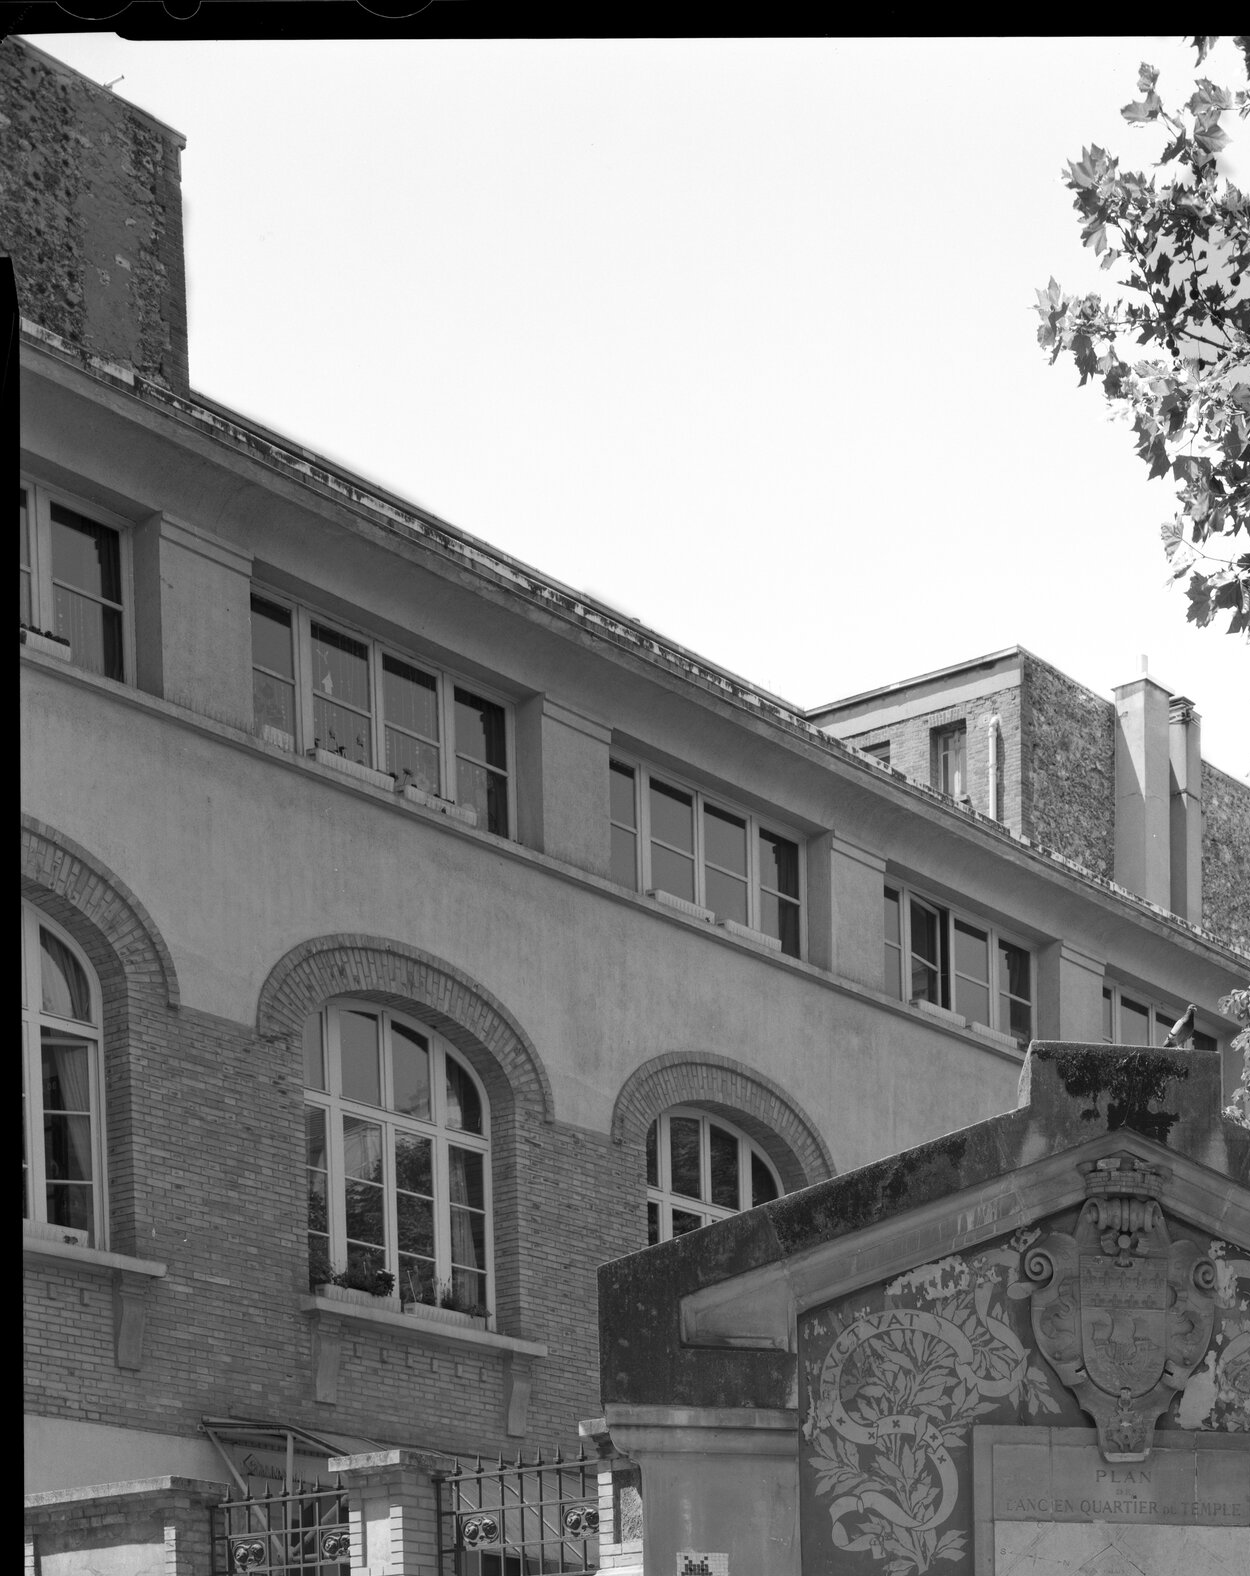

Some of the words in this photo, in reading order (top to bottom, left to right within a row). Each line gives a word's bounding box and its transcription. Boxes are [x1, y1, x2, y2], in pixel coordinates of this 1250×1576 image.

[1096, 1470, 1153, 1484] PLAN
[1080, 1499, 1158, 1515] QUARTIER
[1181, 1502, 1242, 1517] TEMPLE
